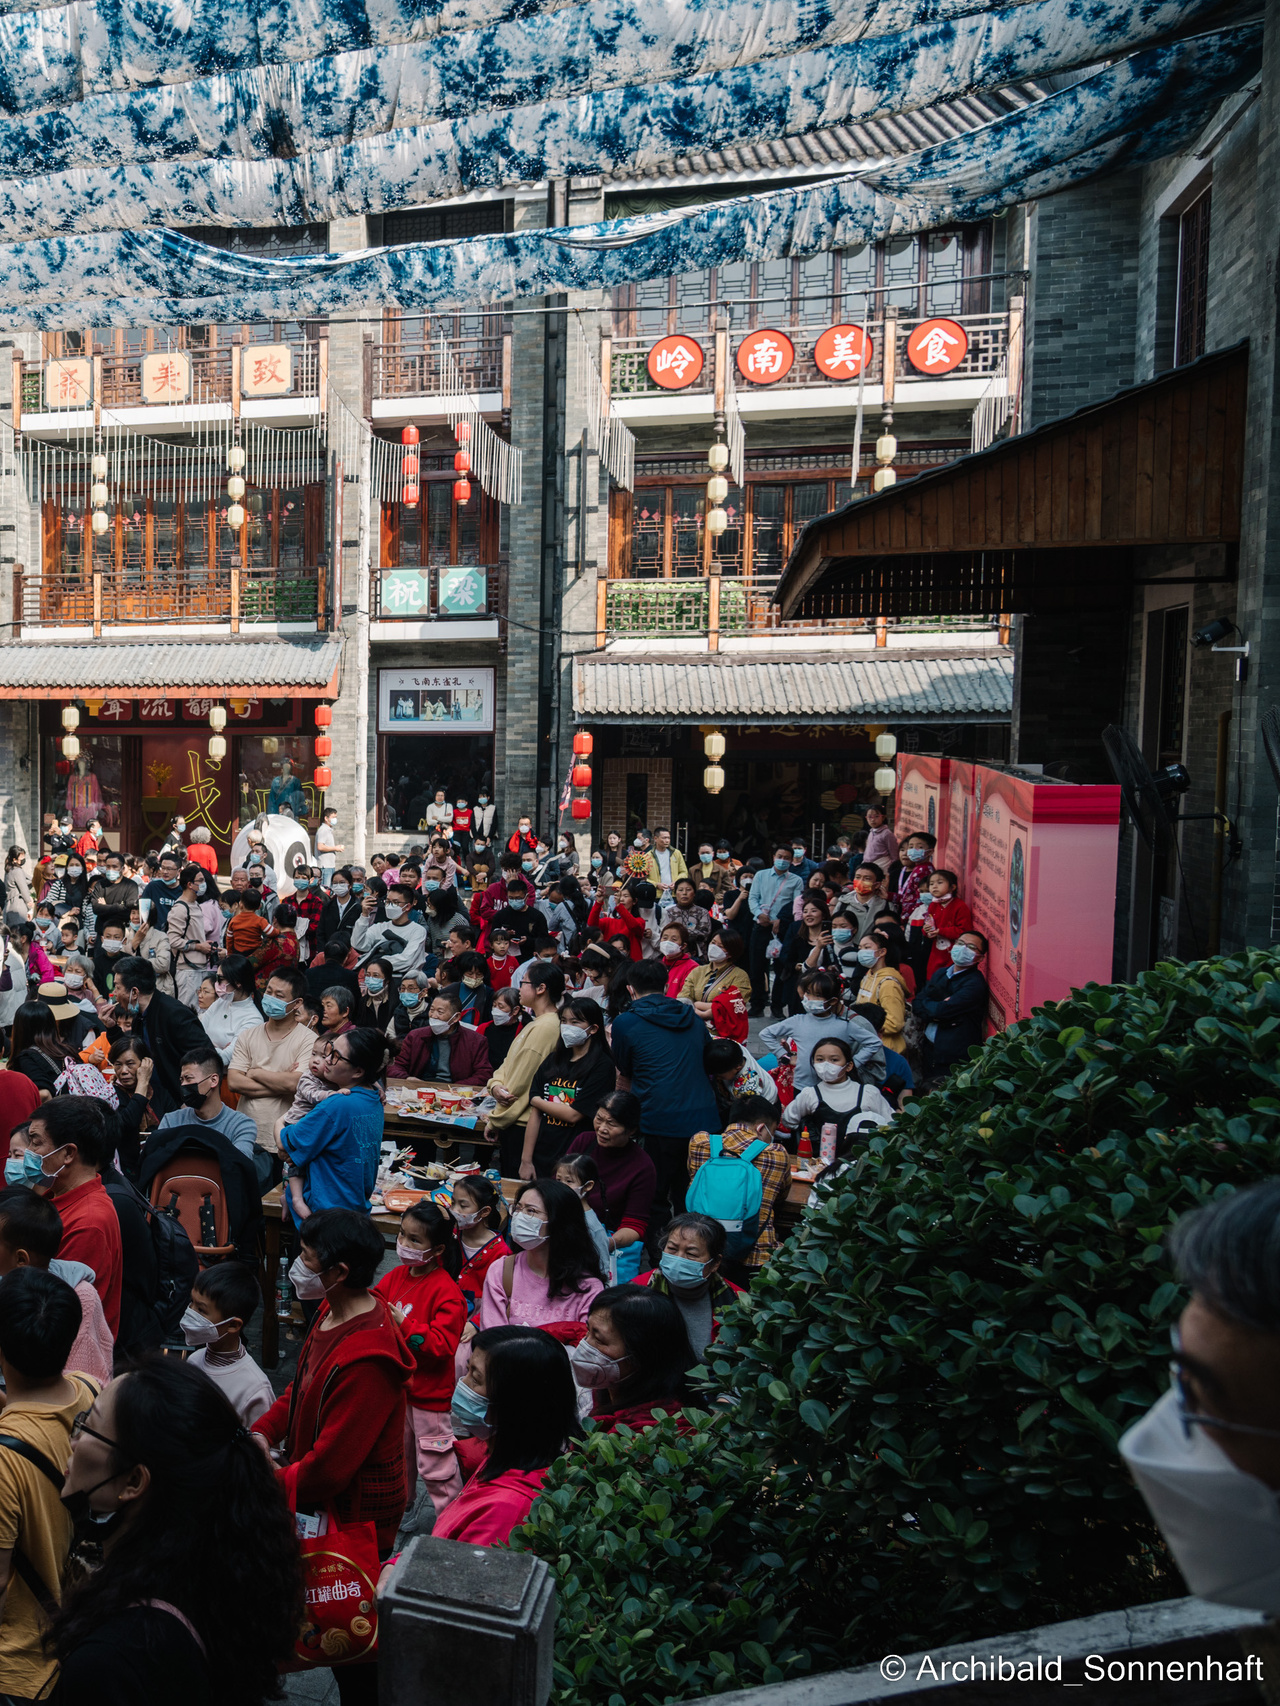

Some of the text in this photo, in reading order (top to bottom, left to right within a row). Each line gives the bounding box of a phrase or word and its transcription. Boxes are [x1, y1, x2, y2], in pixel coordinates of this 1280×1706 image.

[656, 327, 959, 379] 岭南美食
[306, 1580, 361, 1604] 红罐曲奇
